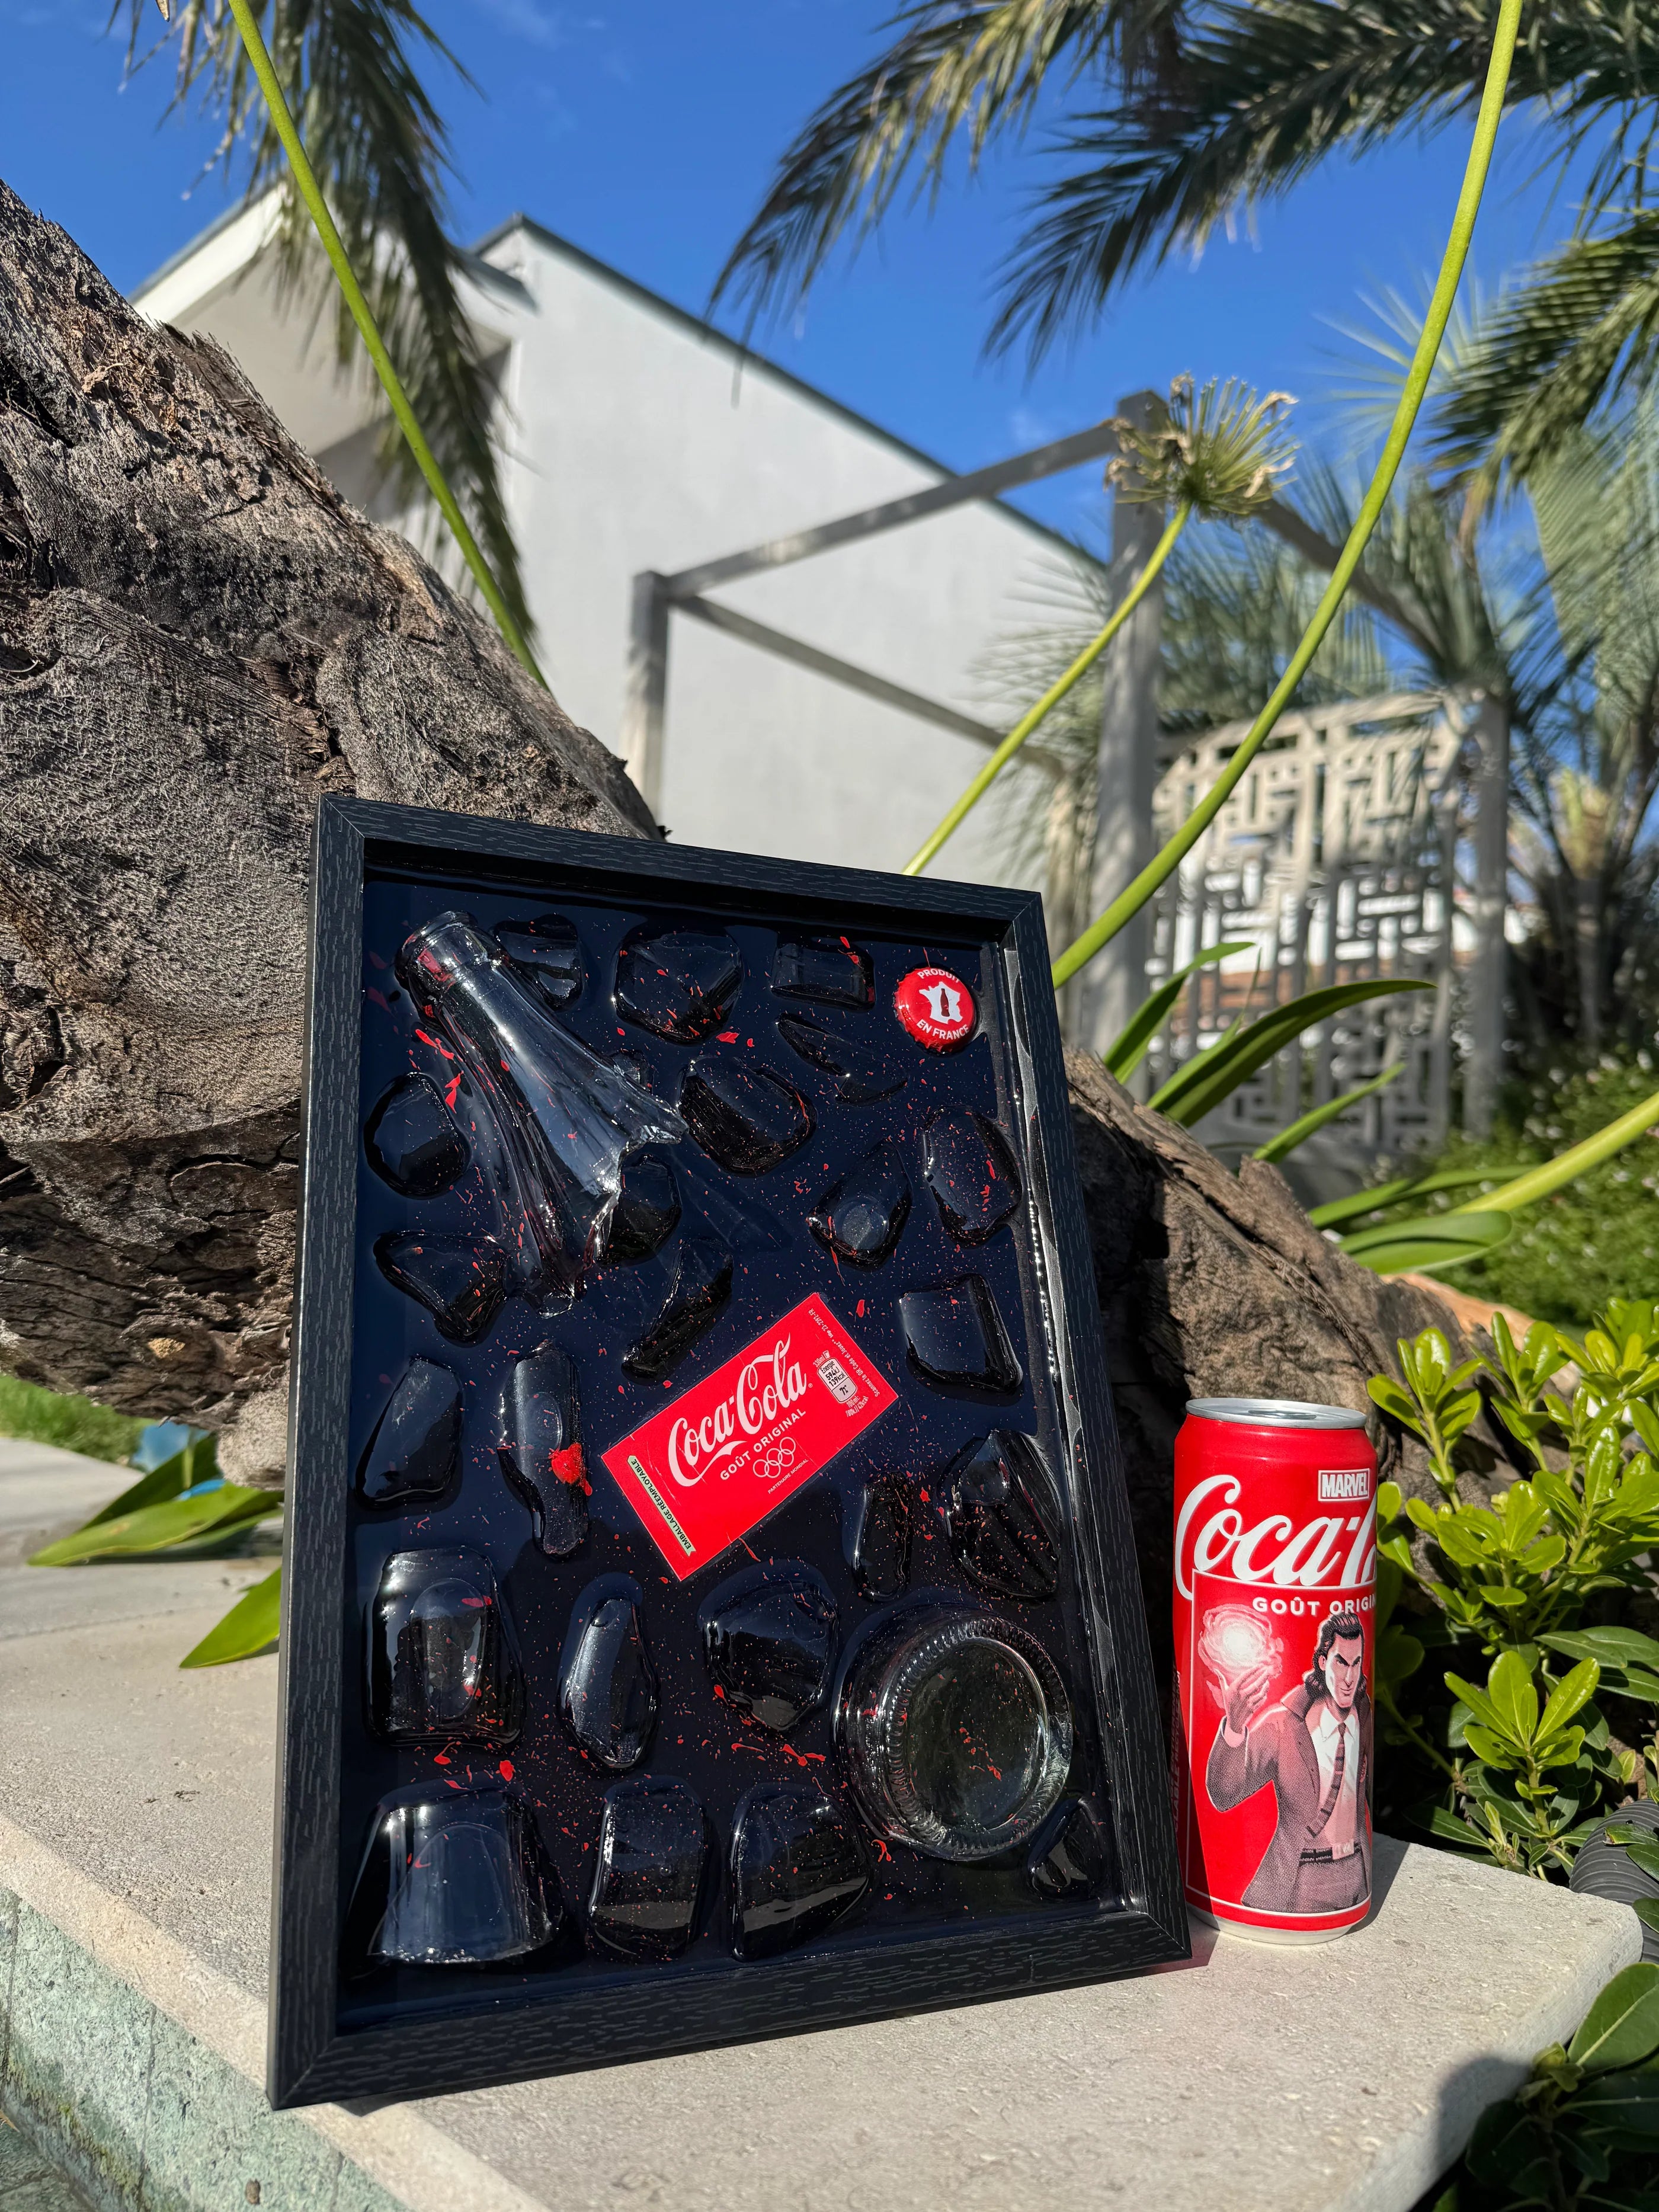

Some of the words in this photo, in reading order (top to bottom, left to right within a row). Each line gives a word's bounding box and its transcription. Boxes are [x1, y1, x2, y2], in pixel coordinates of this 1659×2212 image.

[917, 968, 960, 983] PRODUIT
[917, 1019, 932, 1033] EN
[933, 1024, 969, 1040] FRANCE
[825, 1366, 840, 1381] 594kJ
[848, 1358, 859, 1369] Code
[829, 1372, 846, 1387] 139kcal
[865, 1378, 880, 1397] Scannez
[668, 1331, 808, 1487] Coca-Cola
[720, 1450, 751, 1480] GOÛT
[753, 1408, 806, 1452] ORIGINAL
[631, 1458, 667, 1510] RÉEMPLOYABLE
[767, 1472, 791, 1494] PARTENAIRE
[790, 1458, 809, 1474] MONDIAL
[1321, 1472, 1368, 1498] MARVEL
[664, 1509, 692, 1550] EMBALLAGE
[1253, 1597, 1320, 1616] GOÛT
